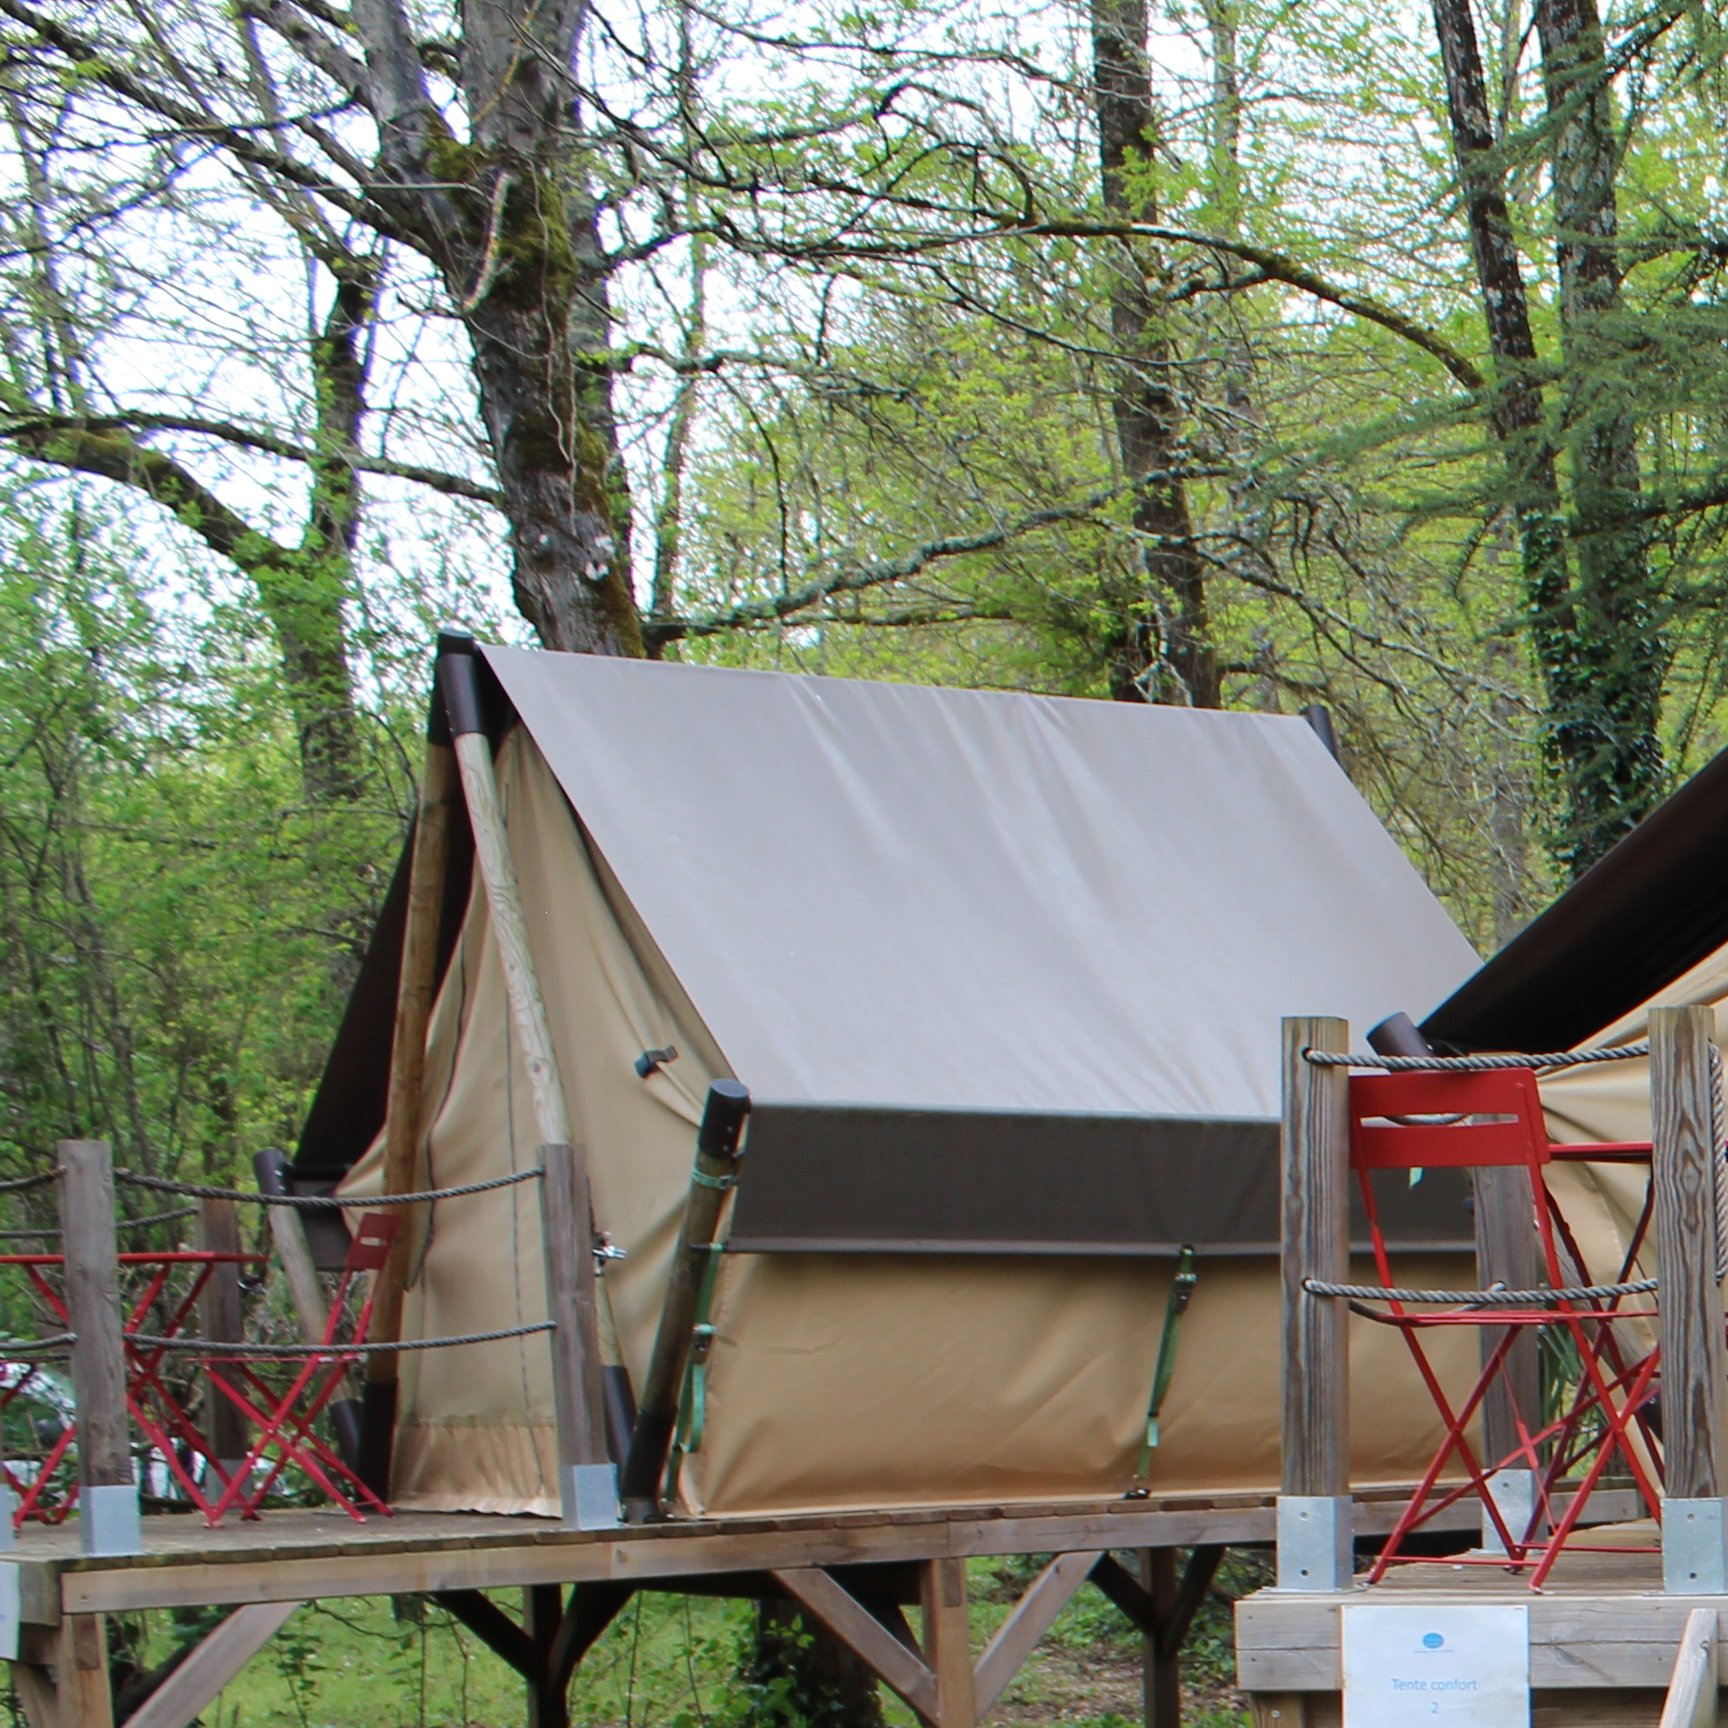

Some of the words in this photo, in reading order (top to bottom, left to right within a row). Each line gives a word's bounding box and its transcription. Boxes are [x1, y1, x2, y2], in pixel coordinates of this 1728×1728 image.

[1392, 1678, 1428, 1692] Tente
[1430, 1678, 1478, 1692] confort
[1431, 1702, 1439, 1714] 2
